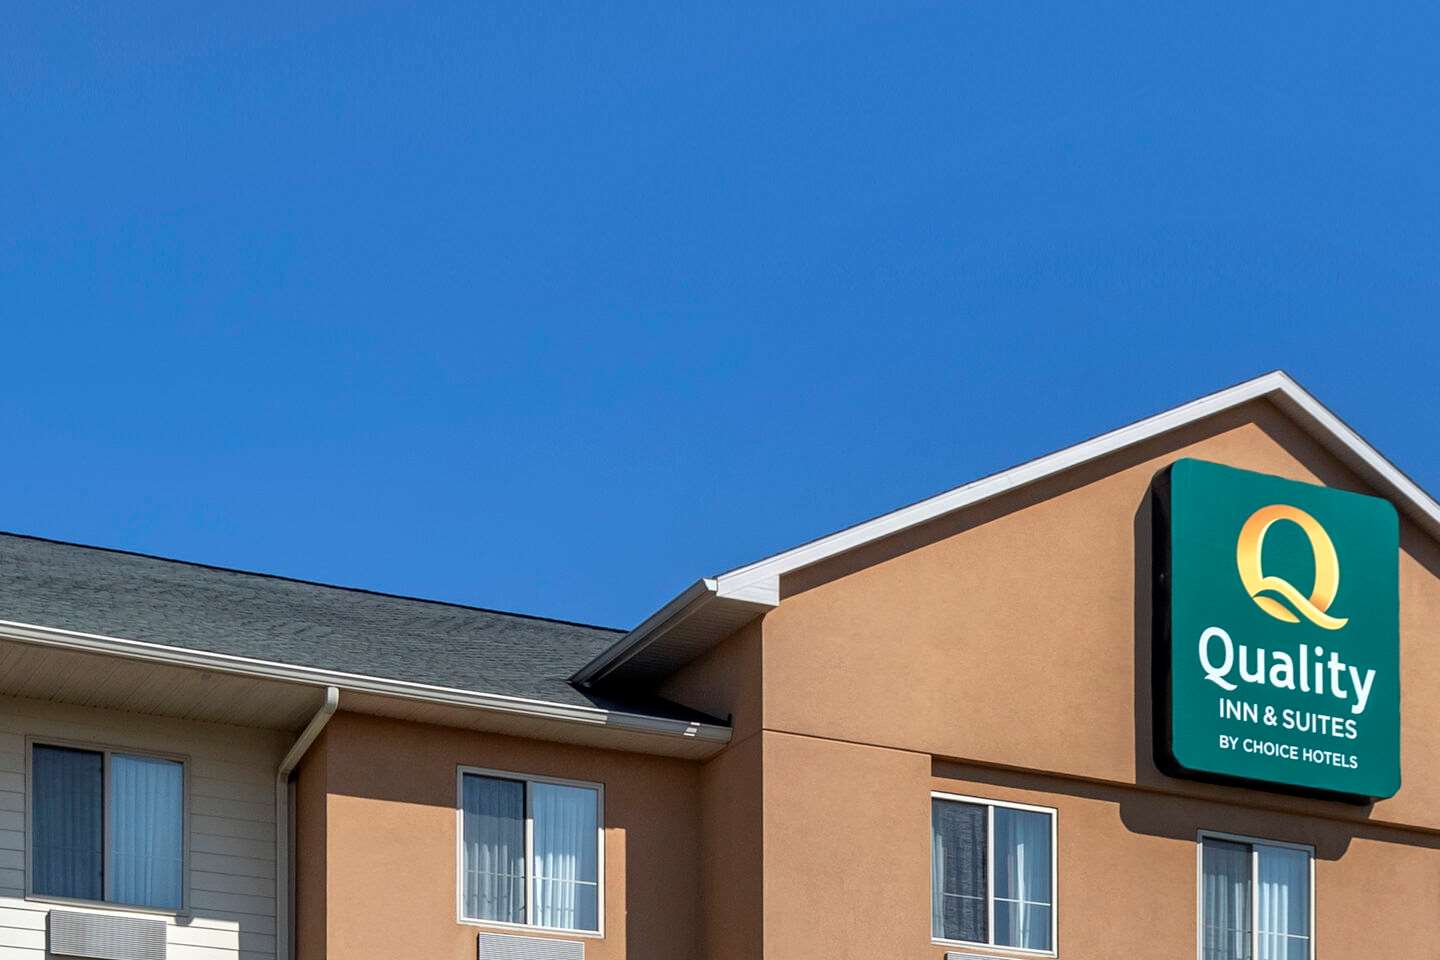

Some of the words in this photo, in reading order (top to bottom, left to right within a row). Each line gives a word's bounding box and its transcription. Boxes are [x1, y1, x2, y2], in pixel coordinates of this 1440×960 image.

[1237, 504, 1349, 630] Q
[1198, 626, 1376, 714] Quality
[1219, 697, 1258, 724] INN
[1263, 705, 1278, 727] &
[1282, 708, 1358, 740] SUITES
[1219, 734, 1239, 750] BY
[1242, 738, 1299, 760] CHOICE
[1302, 747, 1358, 769] HOTELS
